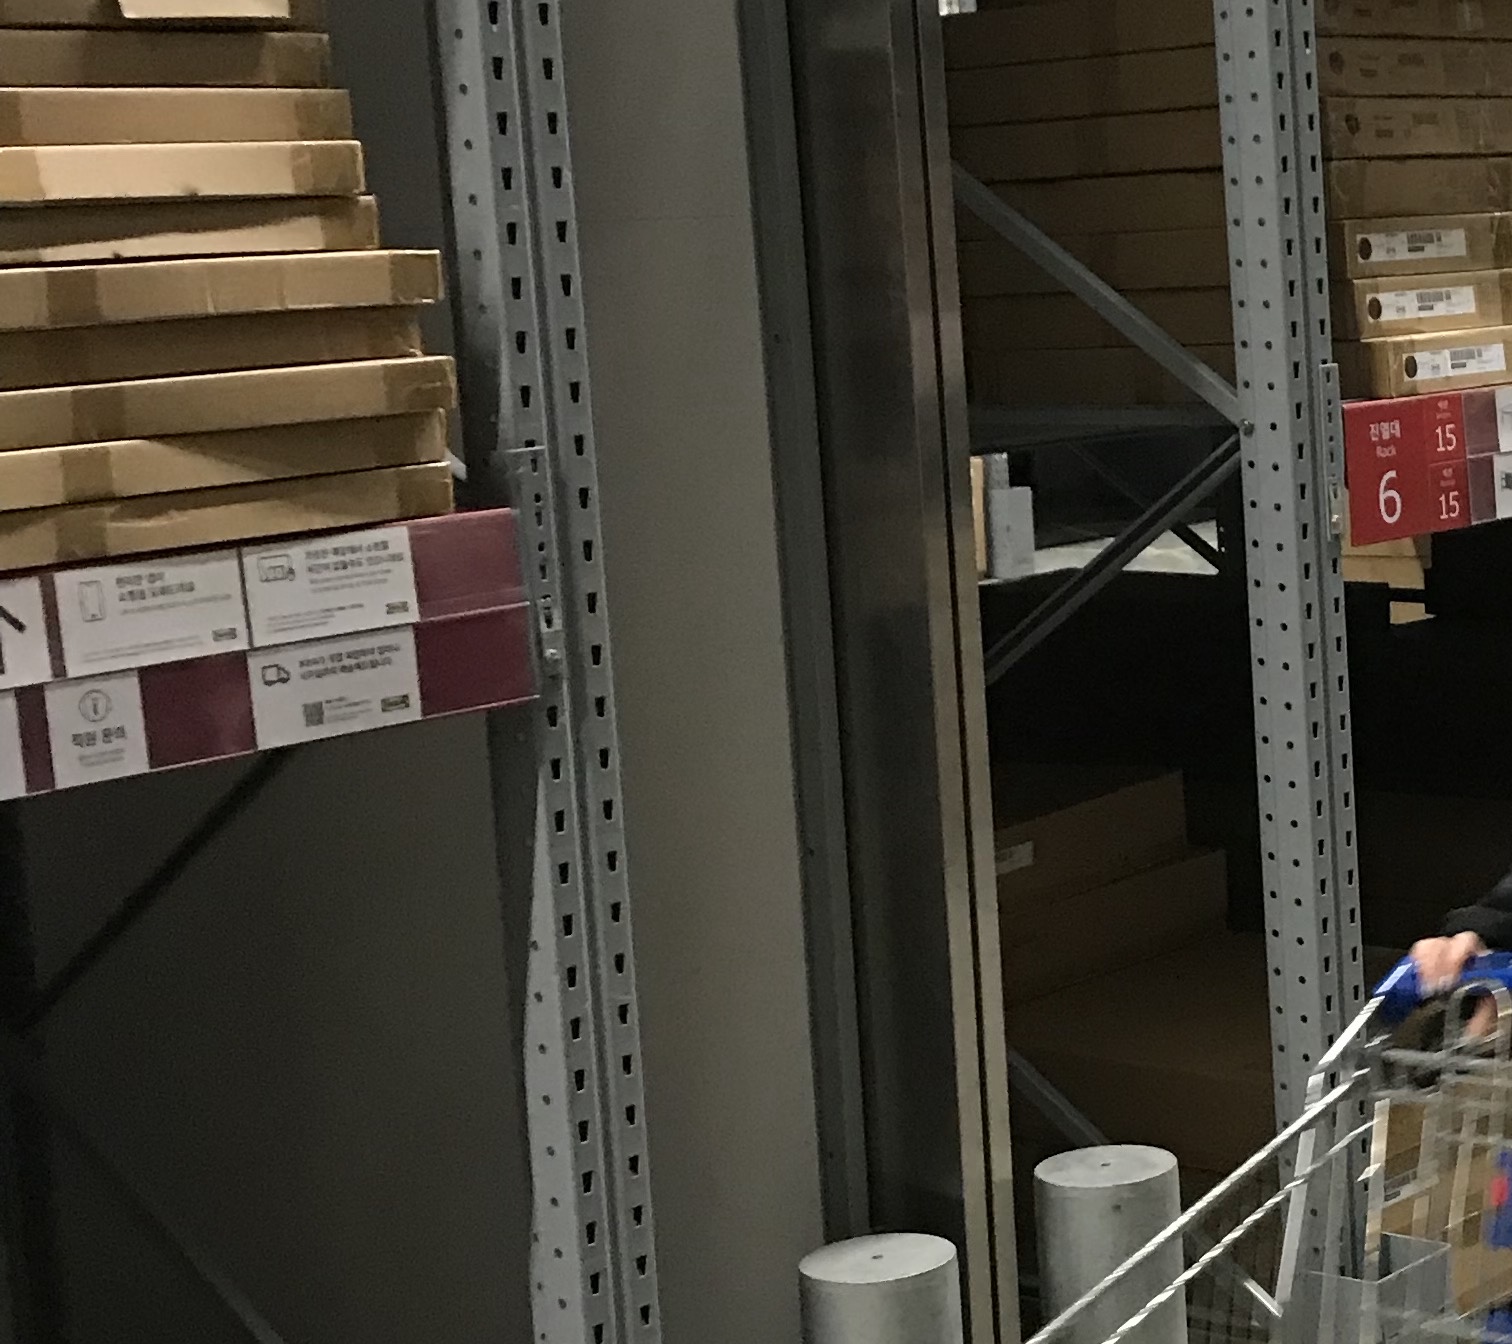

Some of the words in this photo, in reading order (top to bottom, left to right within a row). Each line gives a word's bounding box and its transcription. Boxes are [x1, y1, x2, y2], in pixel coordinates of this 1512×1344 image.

[1435, 423, 1457, 452] 15
[1378, 469, 1402, 524] 6
[1438, 490, 1461, 520] 15
